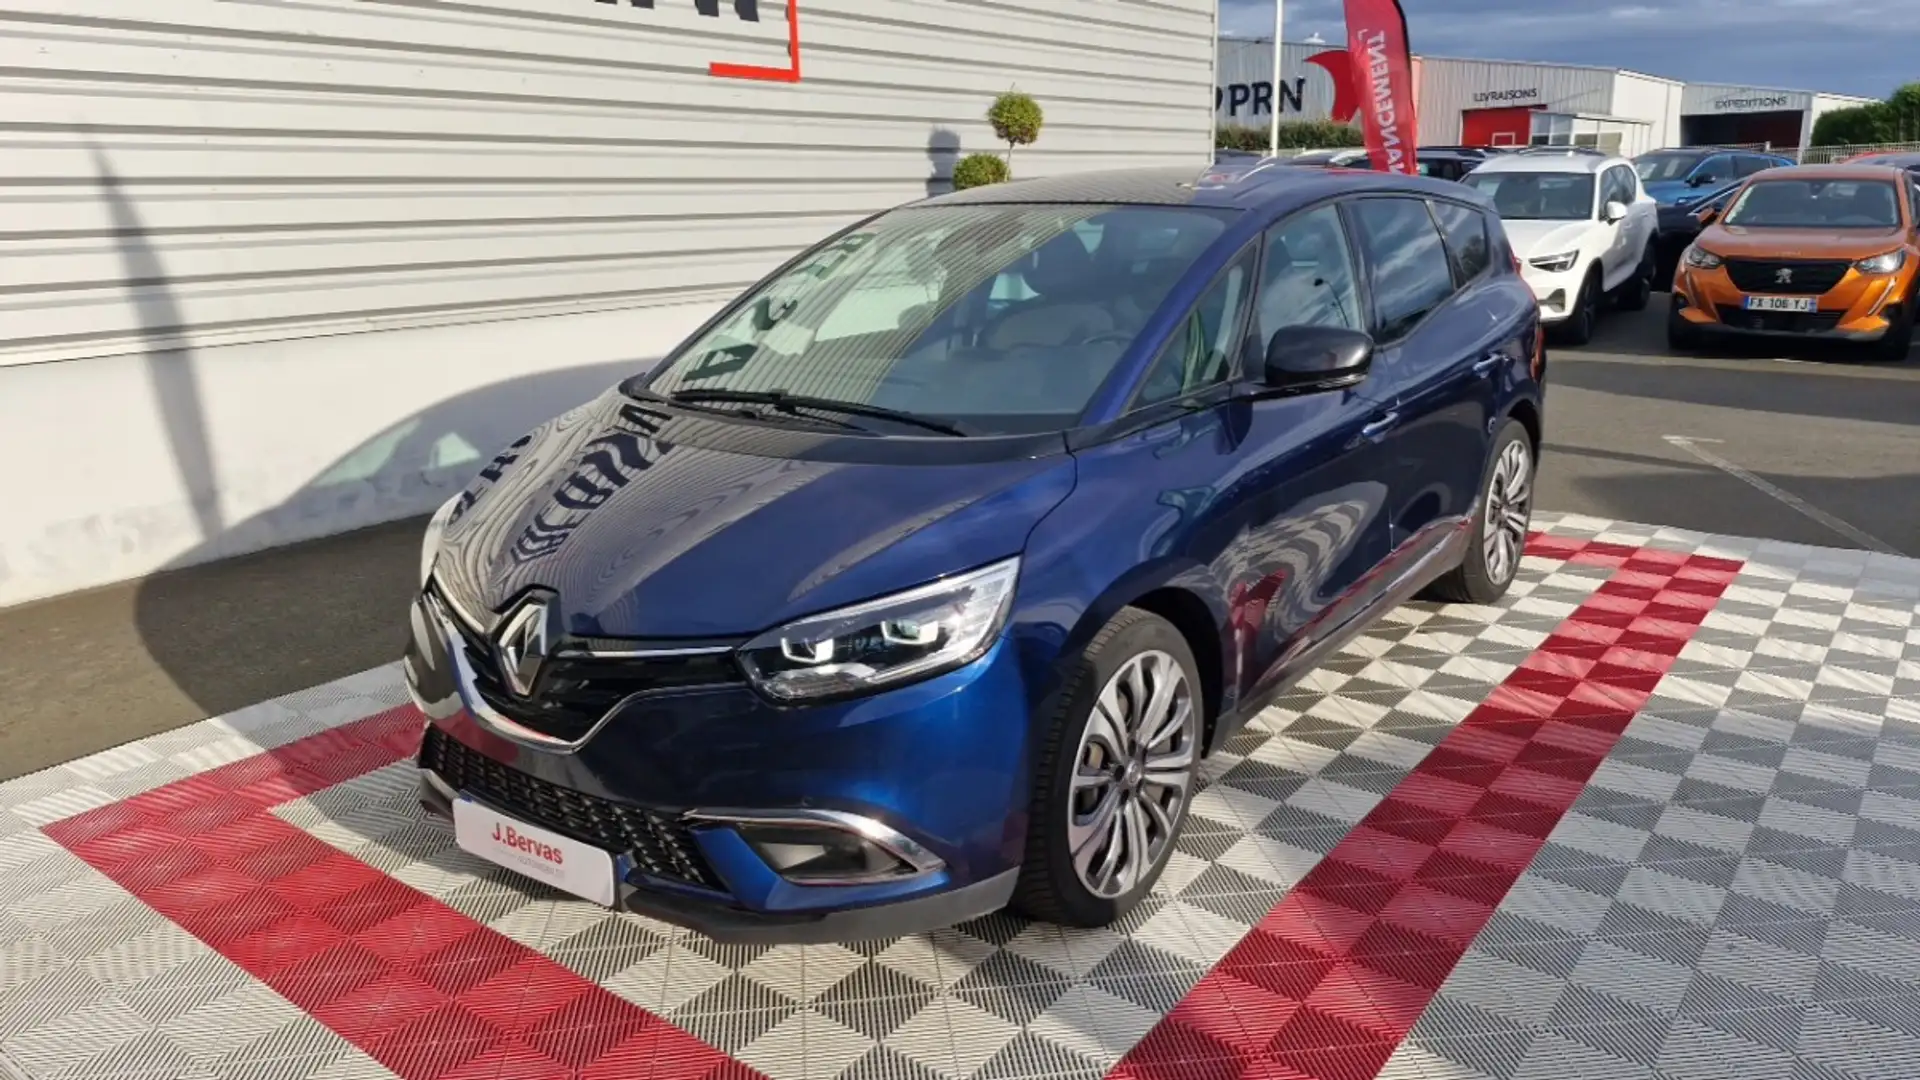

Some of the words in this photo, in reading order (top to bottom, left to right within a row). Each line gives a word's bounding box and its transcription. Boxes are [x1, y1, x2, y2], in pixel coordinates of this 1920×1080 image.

[1215, 78, 1305, 117] PRN
[1474, 88, 1537, 102] LIVRAISONS
[492, 822, 563, 865] J.Bervas
